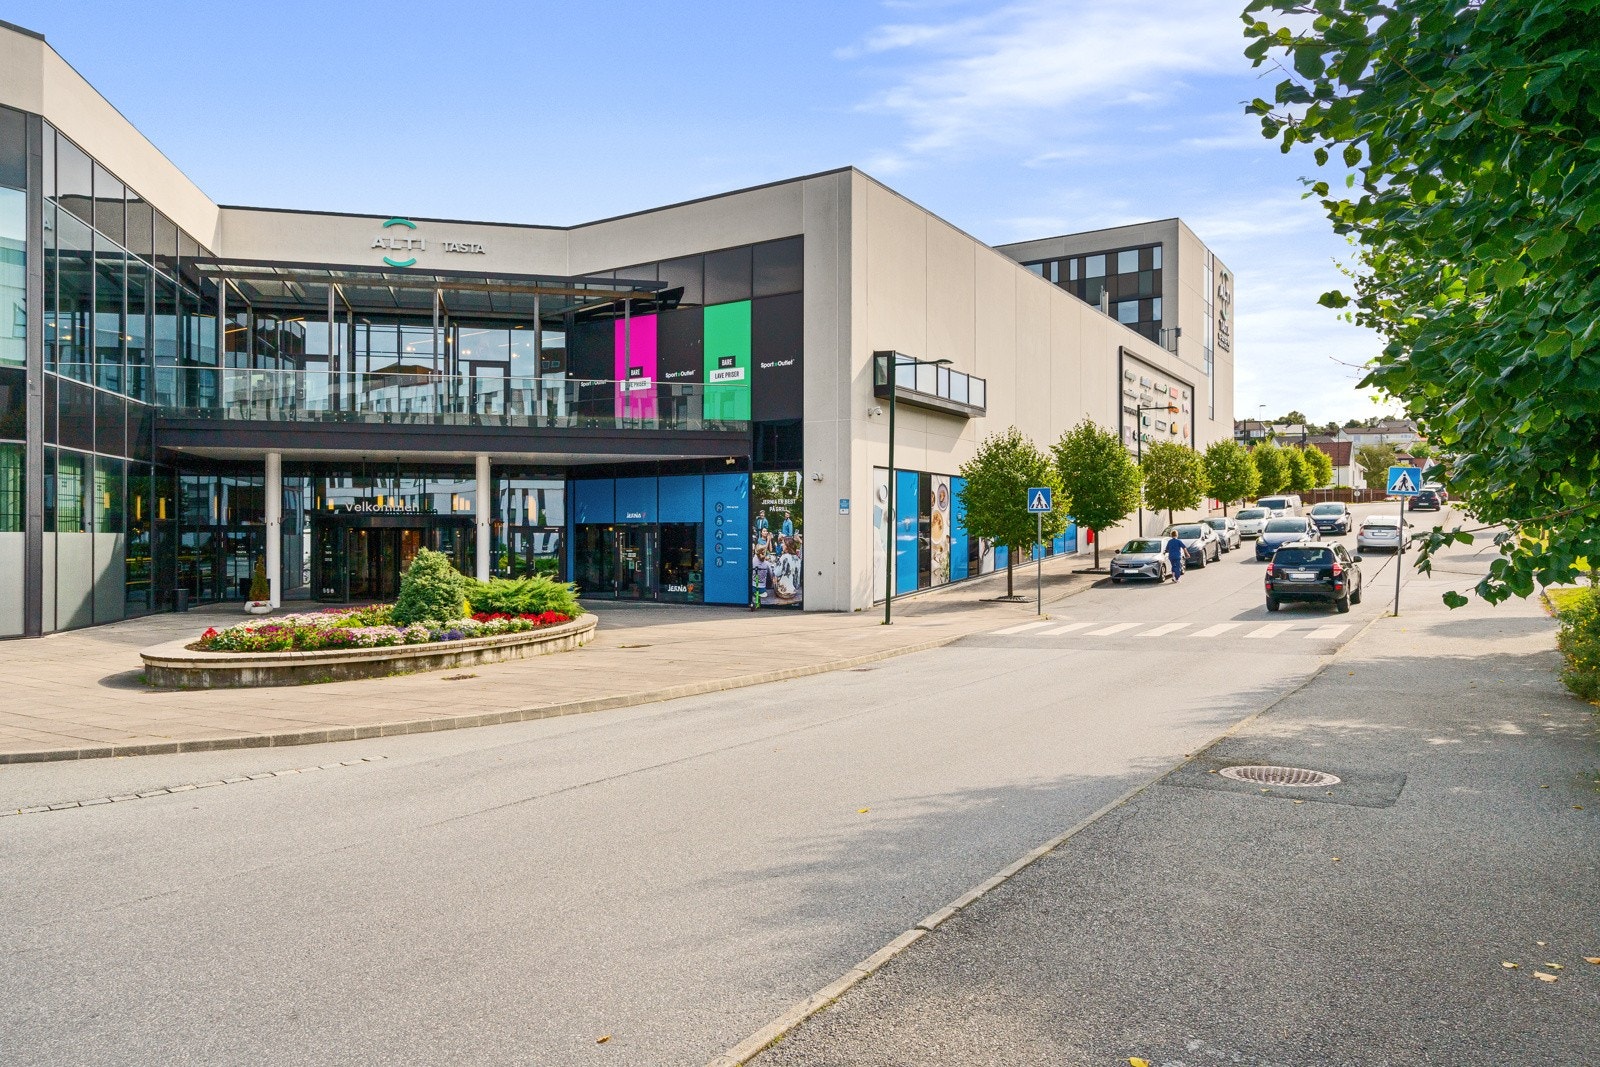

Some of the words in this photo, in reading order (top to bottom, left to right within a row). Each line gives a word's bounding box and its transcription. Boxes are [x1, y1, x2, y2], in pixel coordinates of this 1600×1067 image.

[371, 235, 426, 251] ALTI
[443, 241, 486, 255] TASTA
[760, 361, 774, 369] Sport
[777, 359, 793, 367] Outlet
[665, 371, 678, 379] Sport
[714, 371, 725, 380] LAVE
[725, 370, 740, 378] PRISER
[345, 501, 420, 512] Velkommen
